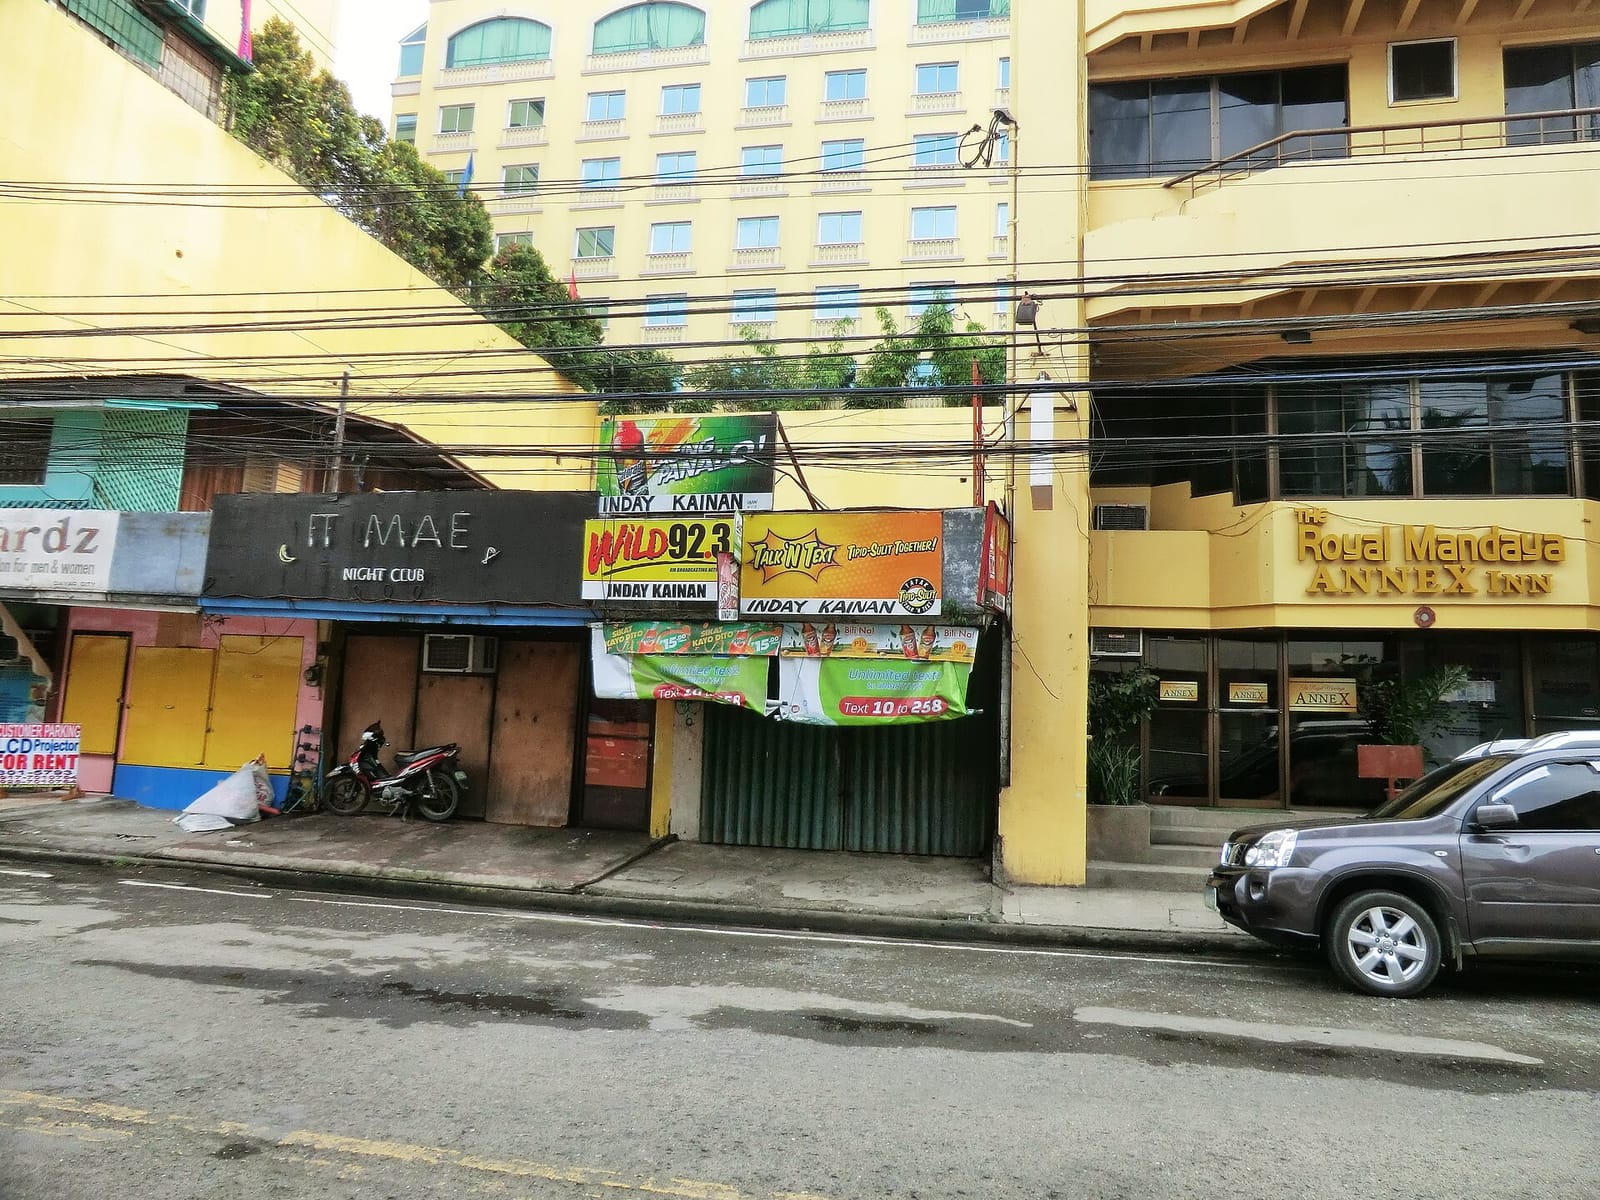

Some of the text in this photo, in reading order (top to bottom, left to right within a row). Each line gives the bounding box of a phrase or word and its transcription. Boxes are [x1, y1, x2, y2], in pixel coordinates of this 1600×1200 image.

[603, 496, 655, 512] INDAY
[673, 494, 743, 511] KAINAN
[364, 511, 471, 548] MAE
[668, 523, 731, 560] 92.3
[1296, 524, 1566, 563] Royal Mandaya
[31, 563, 49, 574] men
[51, 560, 59, 574] &
[61, 563, 95, 575] women
[343, 568, 424, 582] NIGHT CLUB
[1305, 564, 1553, 594] ANNEX INN
[607, 584, 649, 598] INDAY
[652, 584, 707, 598] KAINAN
[747, 600, 896, 614] INDAY KAINAN
[849, 668, 938, 681] Unlimited text
[1163, 689, 1194, 697] ANNEX
[1232, 691, 1264, 699] ANNEX
[1295, 692, 1351, 705] ANNEX
[844, 699, 942, 714] Text 10 to 258
[44, 724, 80, 738] PARKING
[34, 739, 79, 754] Projector
[33, 754, 79, 770] RENT
